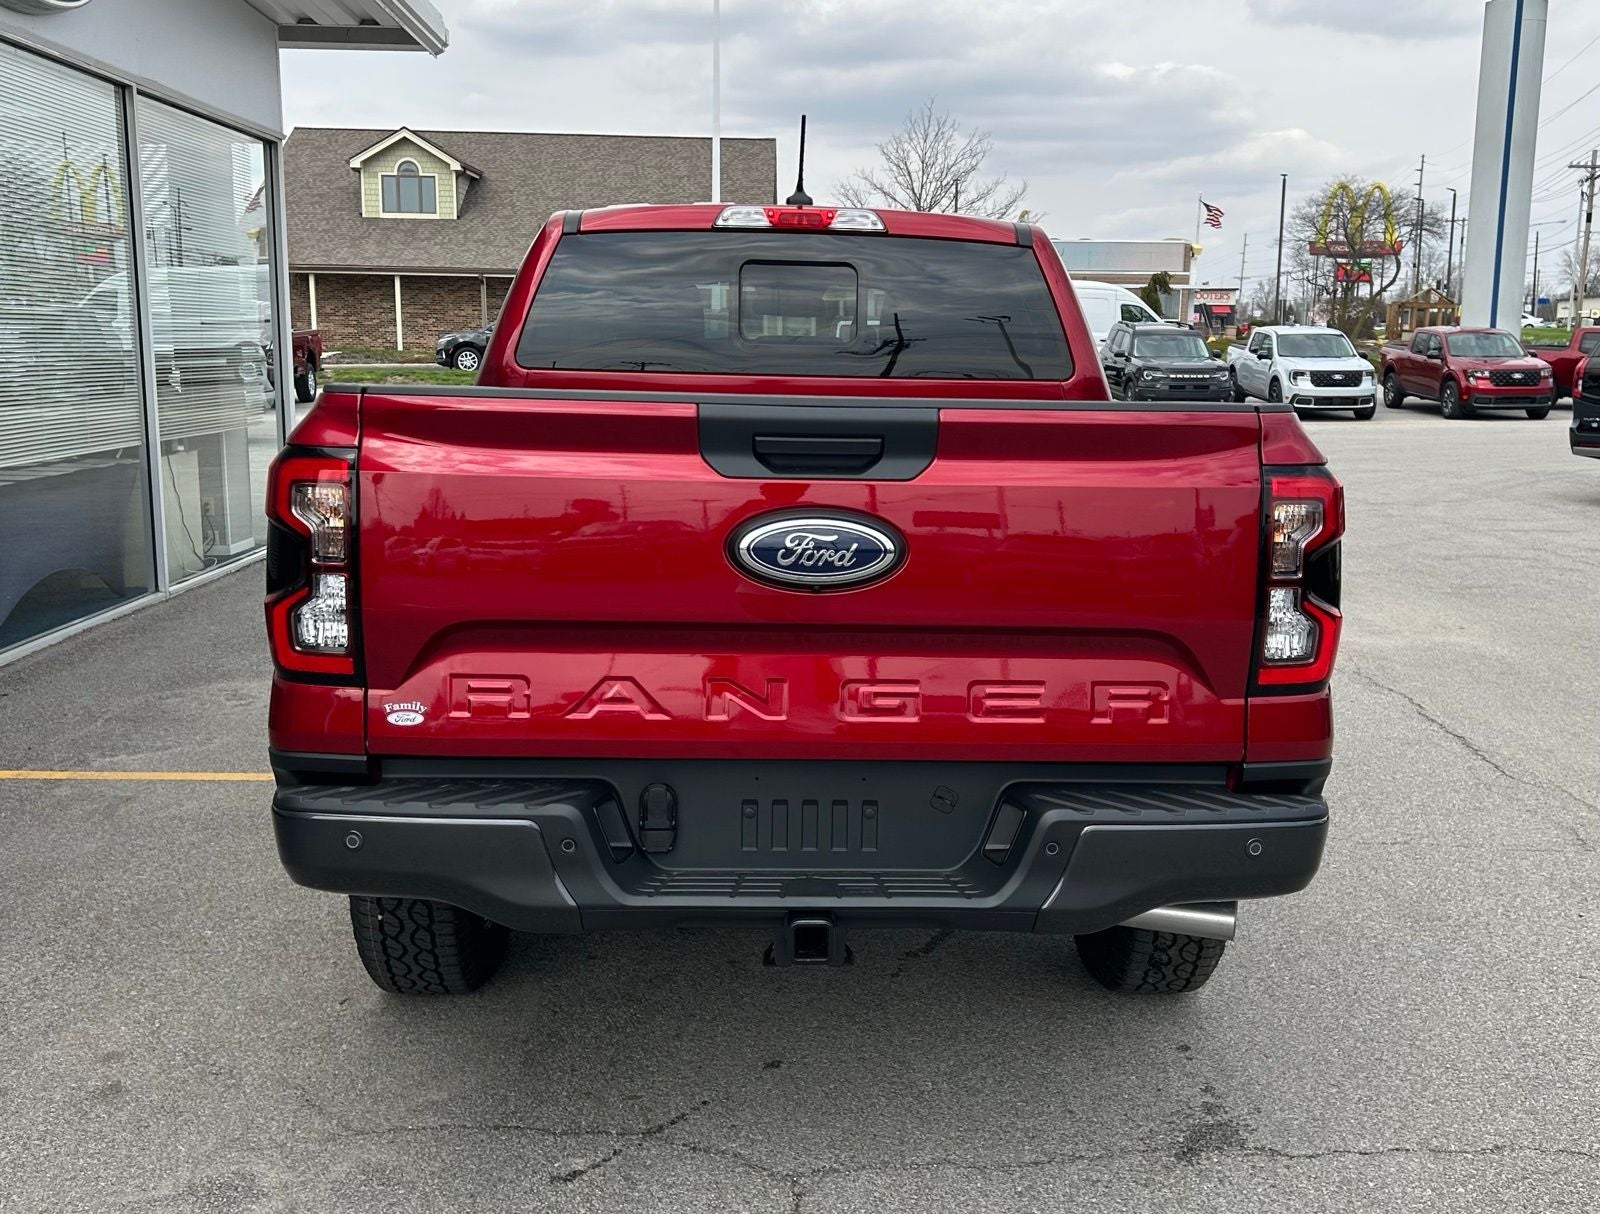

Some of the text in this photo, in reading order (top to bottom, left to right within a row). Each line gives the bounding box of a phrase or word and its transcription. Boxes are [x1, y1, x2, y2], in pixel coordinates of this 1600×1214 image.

[1195, 291, 1231, 300] OOTER'S
[776, 532, 860, 567] Ford
[448, 673, 1170, 725] RANGER
[384, 701, 428, 714] Family
[394, 713, 418, 723] Ford
